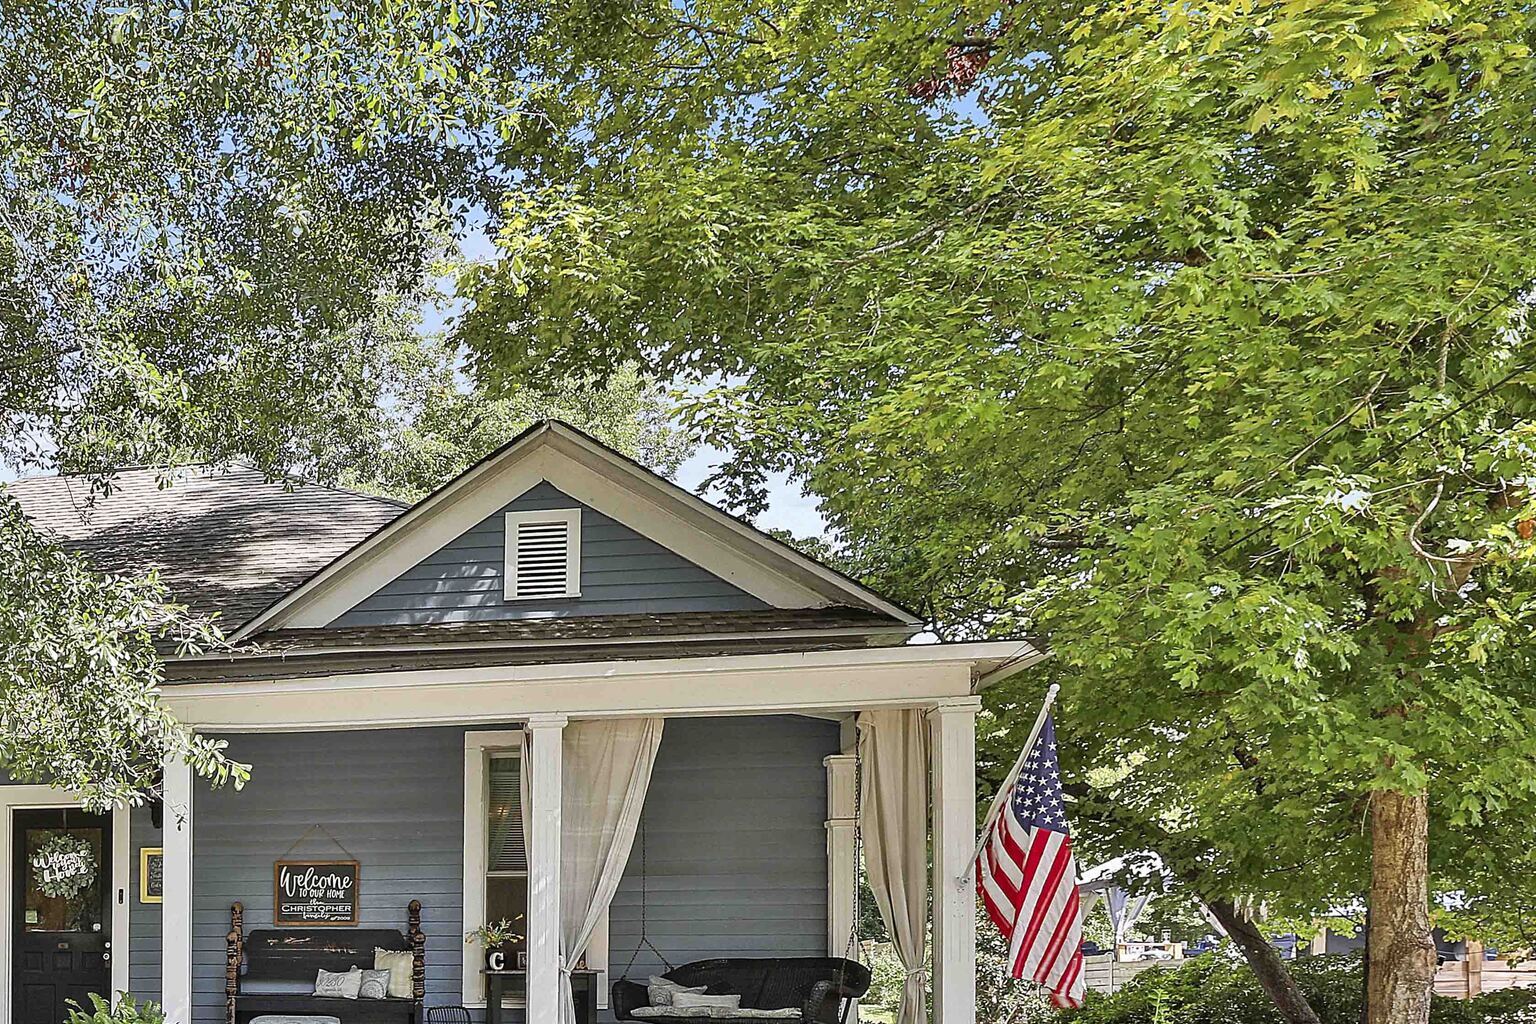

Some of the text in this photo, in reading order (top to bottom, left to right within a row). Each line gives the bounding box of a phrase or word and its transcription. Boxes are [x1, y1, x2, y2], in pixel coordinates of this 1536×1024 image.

[280, 866, 353, 897] Welcome
[299, 888, 345, 899] TO OUR HOME
[489, 952, 505, 970] C
